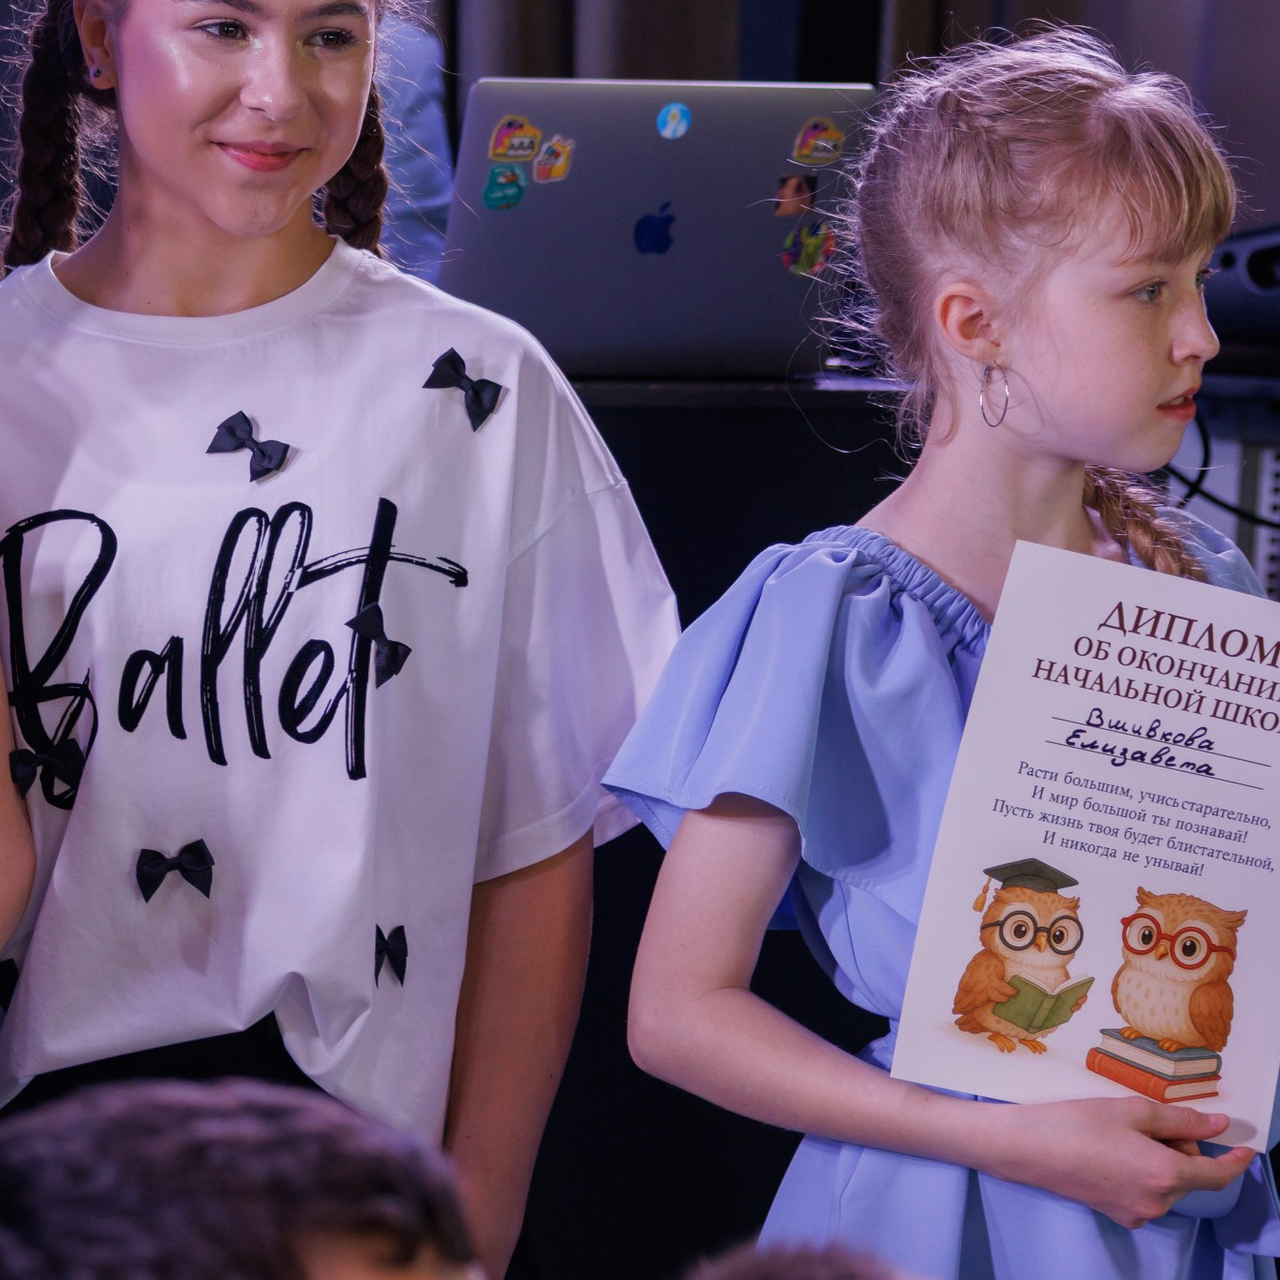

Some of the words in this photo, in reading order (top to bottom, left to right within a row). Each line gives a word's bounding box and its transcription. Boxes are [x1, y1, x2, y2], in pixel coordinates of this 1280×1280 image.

[1097, 601, 1280, 669] ДИПЛОМ
[1032, 658, 1207, 715] НАЧАЛЬНОЙ
[1210, 698, 1280, 735] ШКО
[1074, 636, 1112, 661] ОБ
[1117, 646, 1280, 703] ОКОНЧАНИ
[1065, 729, 1216, 777] Елизавета
[1086, 707, 1215, 751] Вшивкова
[1017, 761, 1058, 782] Расти
[1063, 771, 1134, 800] большим,
[1137, 789, 1179, 809] учись
[1181, 799, 1271, 831] старательно,
[1031, 785, 1045, 800] И
[1048, 792, 1079, 810] мир
[1083, 796, 1147, 822] большой
[1151, 813, 1171, 827] ты
[1174, 818, 1248, 844] познавай!
[992, 798, 1035, 820] Пусть
[1038, 811, 1084, 830] жизнь
[1088, 821, 1120, 838] твоя
[1123, 827, 1163, 848] будет
[1166, 837, 1275, 873] блистательной,
[1042, 830, 1057, 845] И
[1060, 837, 1117, 859] никогда
[1122, 850, 1140, 863] не
[1144, 853, 1205, 877] унывай!
